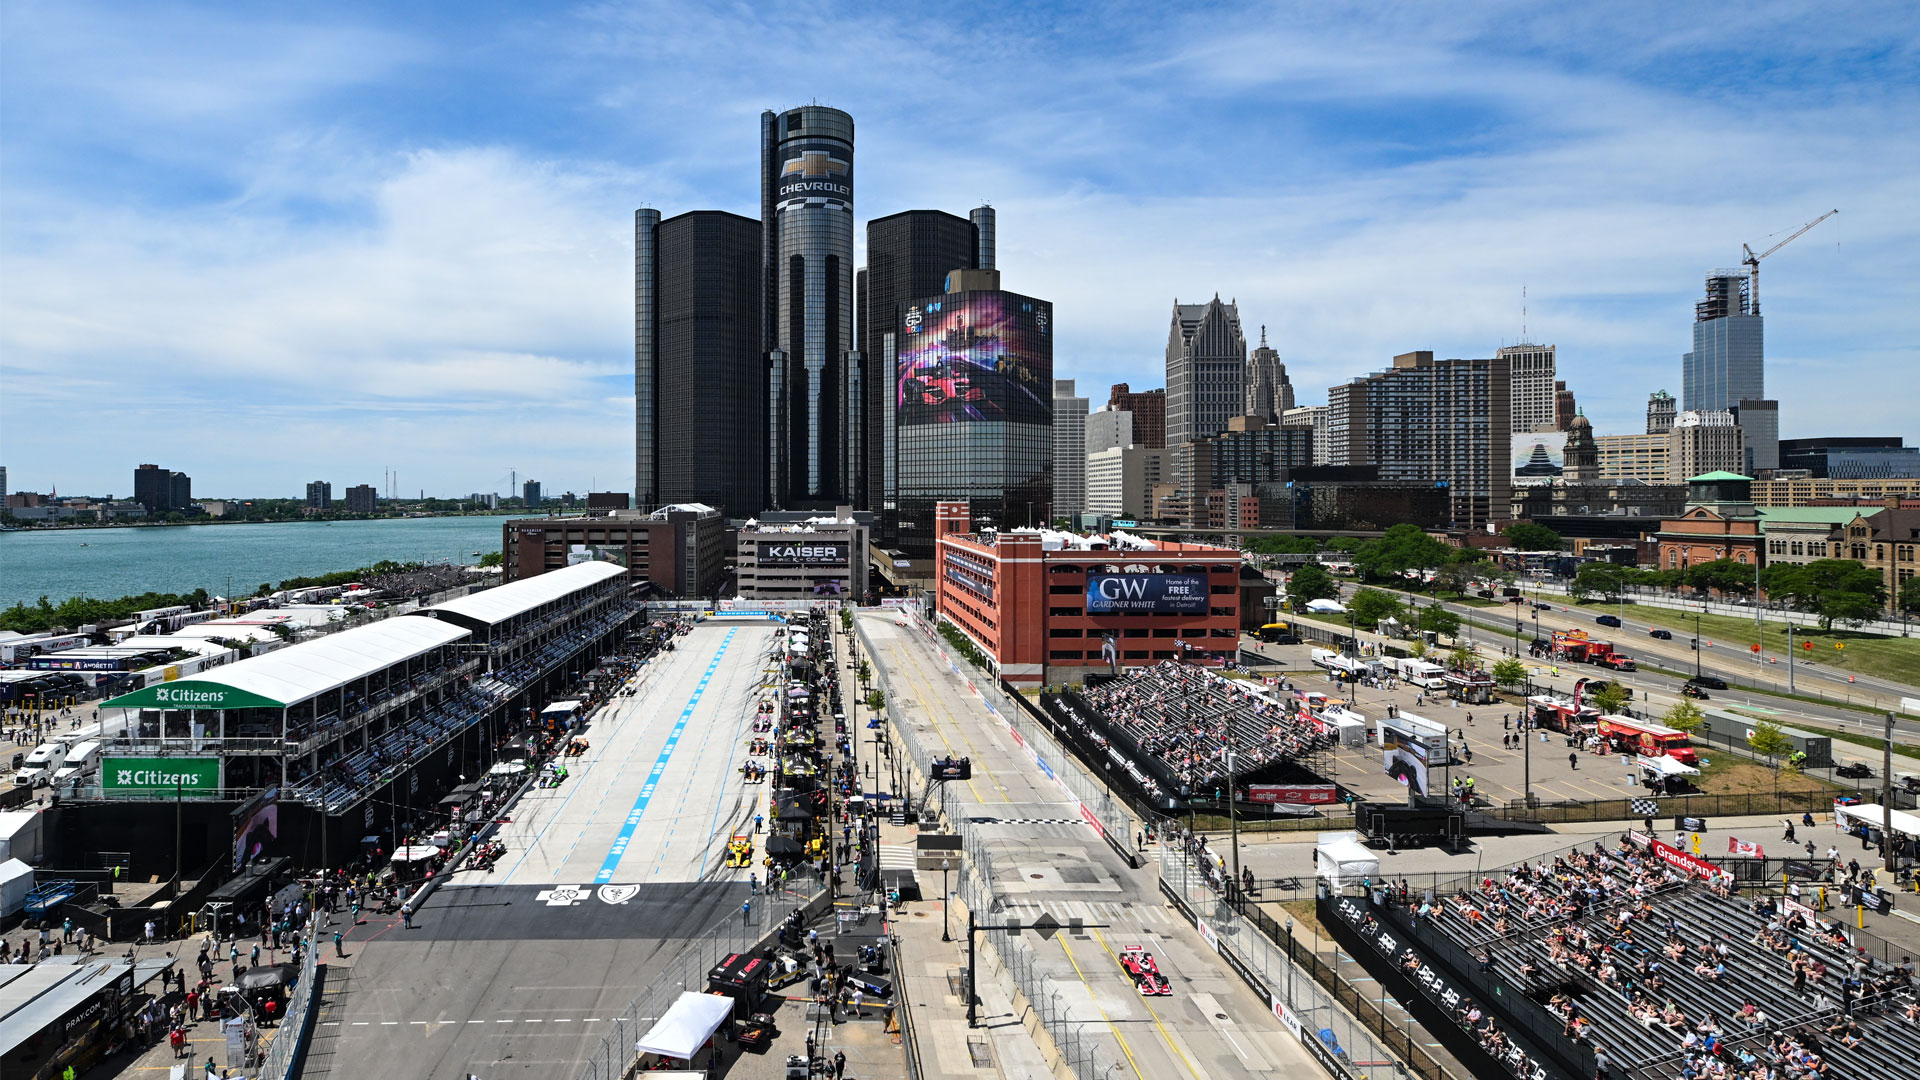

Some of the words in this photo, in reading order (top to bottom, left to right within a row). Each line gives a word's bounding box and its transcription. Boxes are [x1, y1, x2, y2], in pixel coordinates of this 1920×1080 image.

[780, 182, 850, 196] CHEVROLET
[769, 547, 837, 557] KAISER
[1099, 578, 1149, 600] GW
[1168, 586, 1190, 594] FREE
[1092, 600, 1129, 608] GARDNER
[1131, 600, 1156, 608] WHITE
[1181, 594, 1205, 602] delivery
[83, 661, 113, 669] ANDRETTI
[170, 689, 224, 702] Citizens
[134, 770, 199, 785] Citizens
[1255, 791, 1278, 800] meijer
[1205, 931, 1216, 944] LEAR
[744, 958, 762, 973] IMSA
[65, 1001, 101, 1031] PRAY.COM
[1283, 1013, 1298, 1031] LEAR
